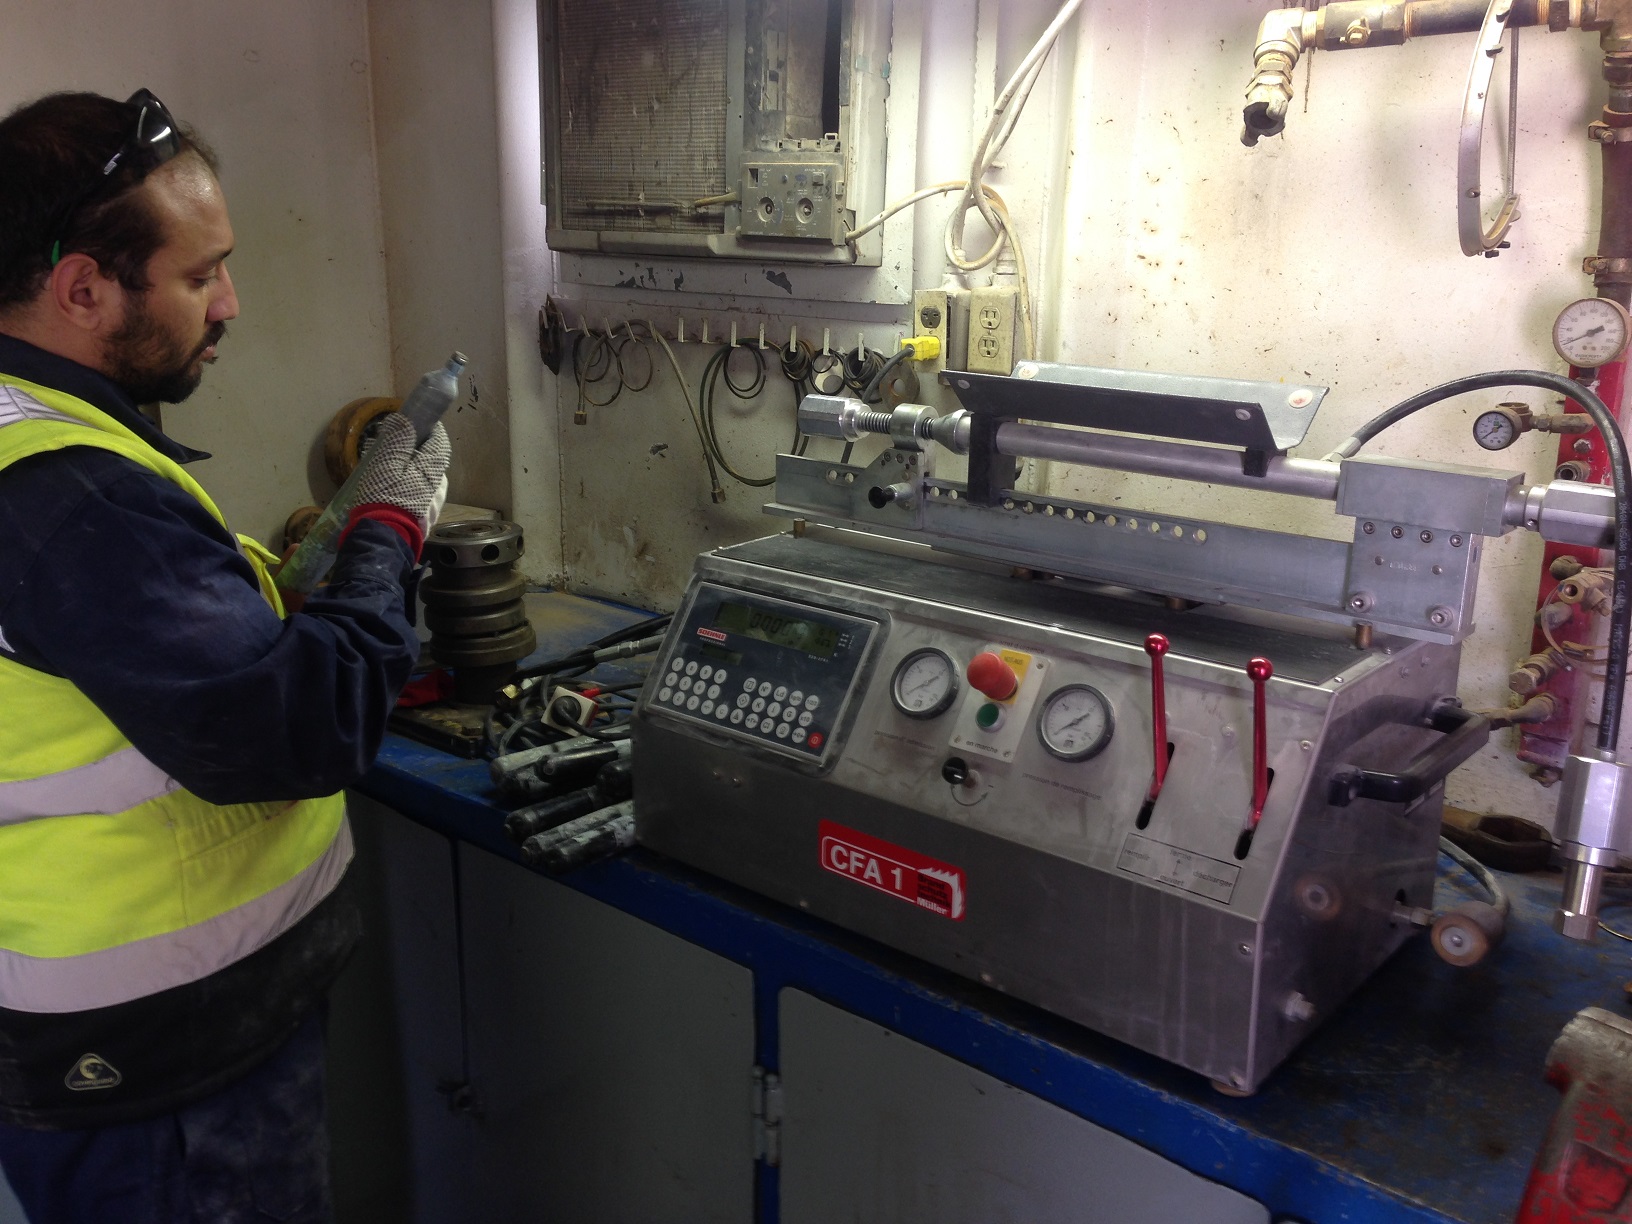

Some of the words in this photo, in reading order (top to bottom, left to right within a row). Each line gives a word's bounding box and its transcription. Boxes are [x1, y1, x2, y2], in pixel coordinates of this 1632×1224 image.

[698, 628, 726, 640] SOEHNLE
[965, 739, 974, 747] en
[974, 741, 998, 754] marche
[830, 845, 883, 885] CFA
[891, 867, 903, 891] 1
[917, 896, 947, 914] Müller
